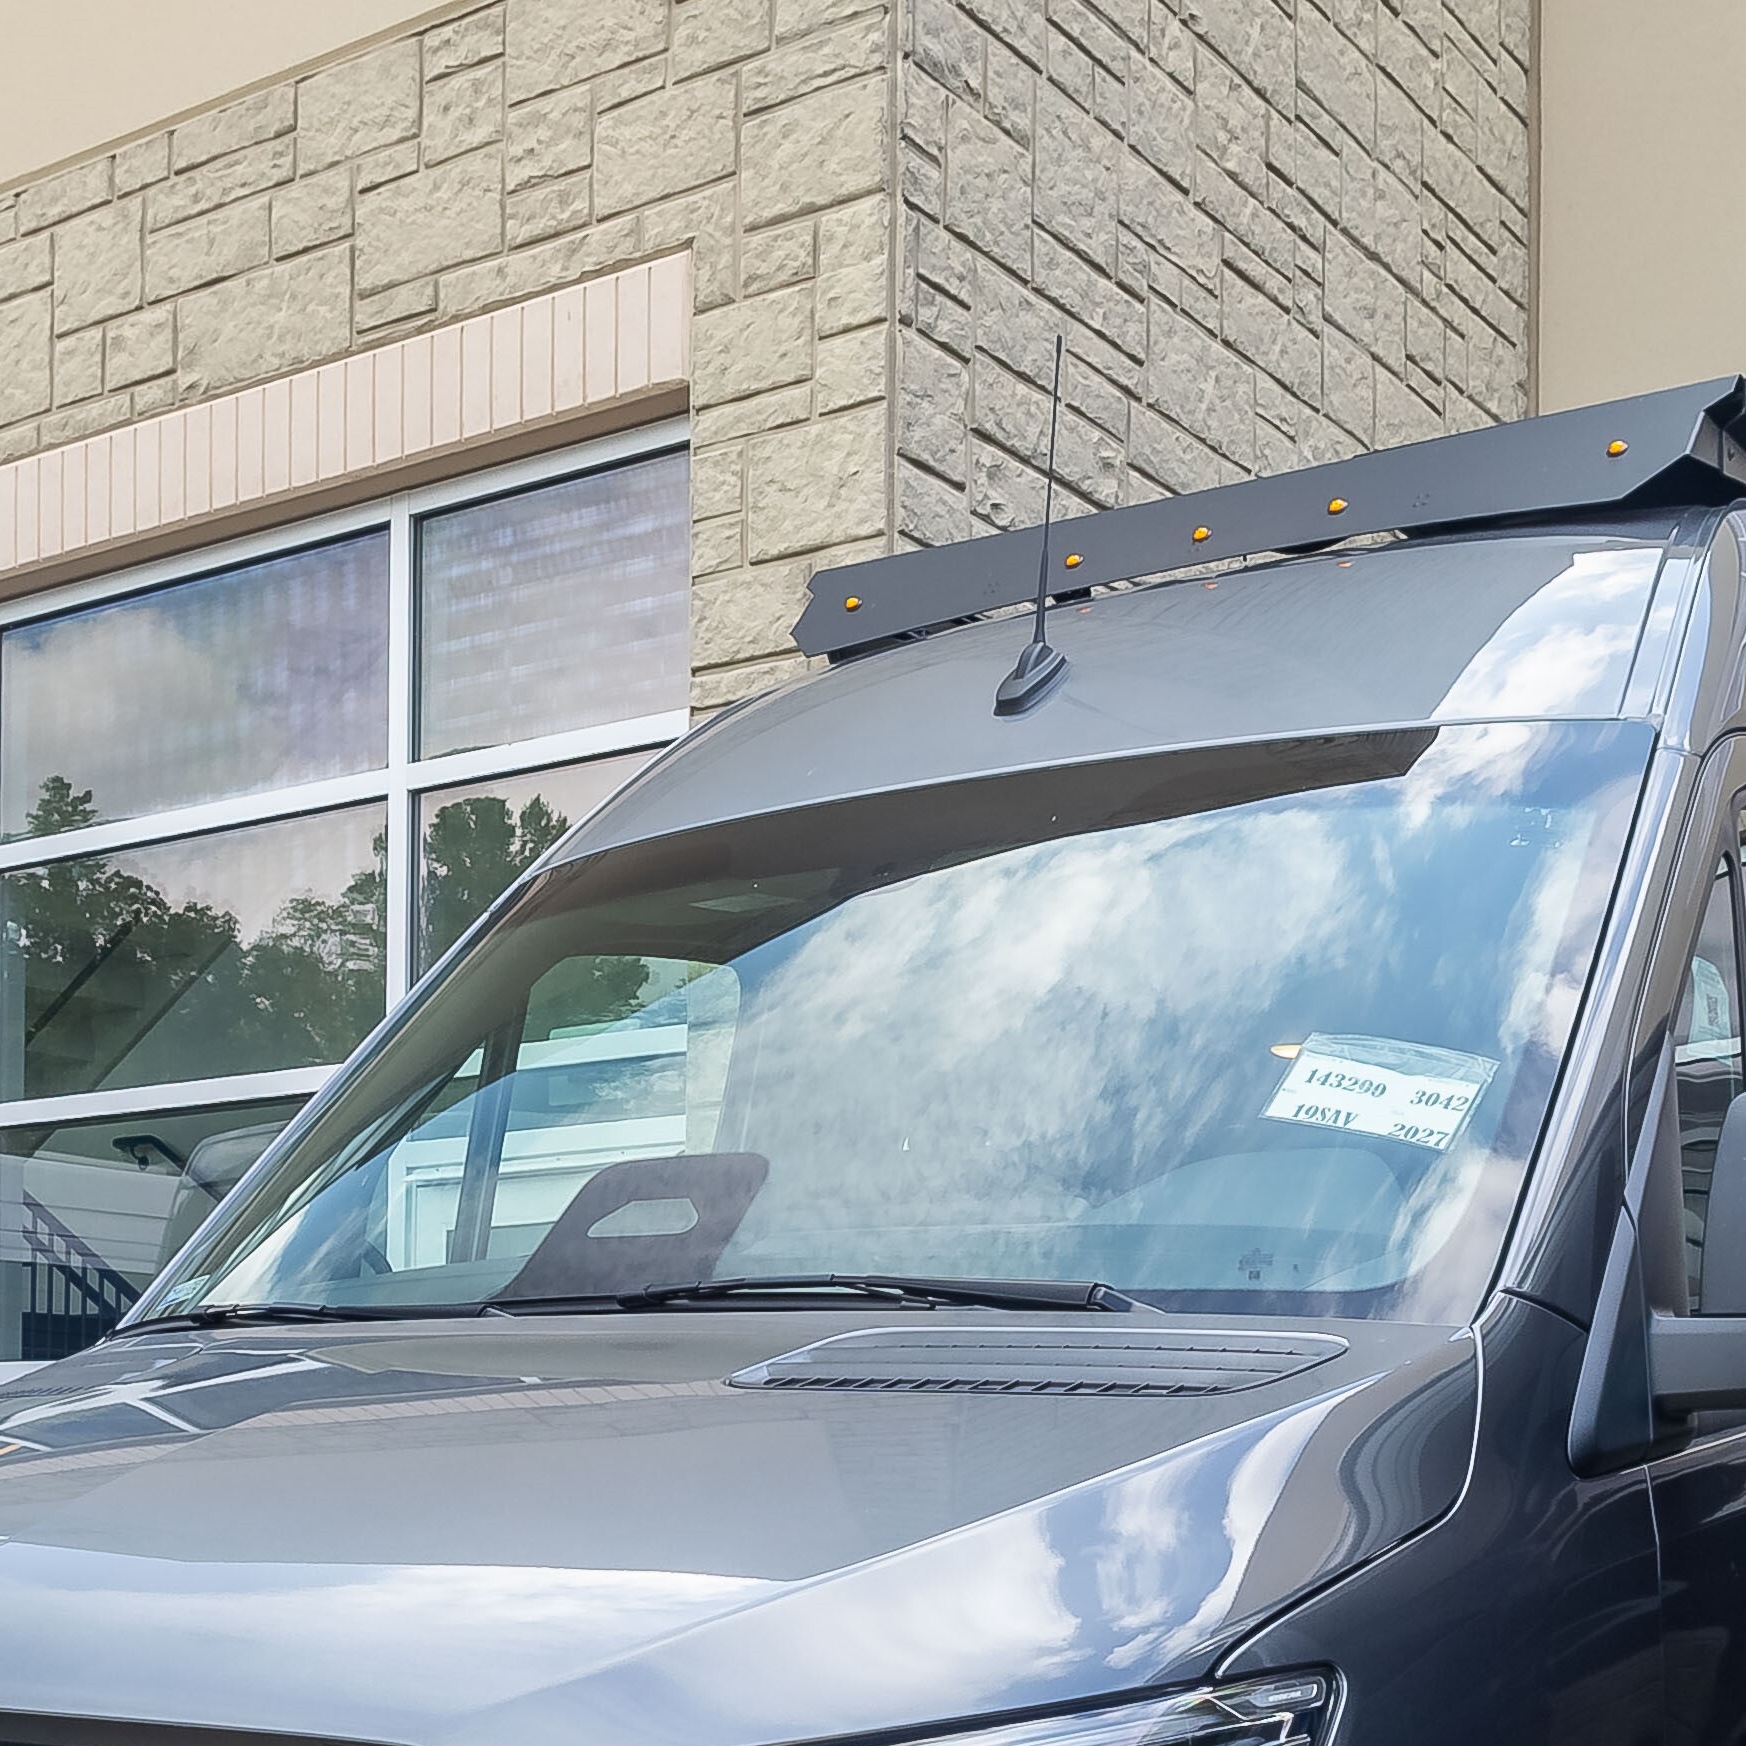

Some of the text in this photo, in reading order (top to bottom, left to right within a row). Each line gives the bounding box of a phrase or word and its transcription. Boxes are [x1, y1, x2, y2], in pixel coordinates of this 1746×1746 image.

[1409, 1089, 1470, 1112] 3042
[1293, 1103, 1451, 1148] 19SAV 2027
